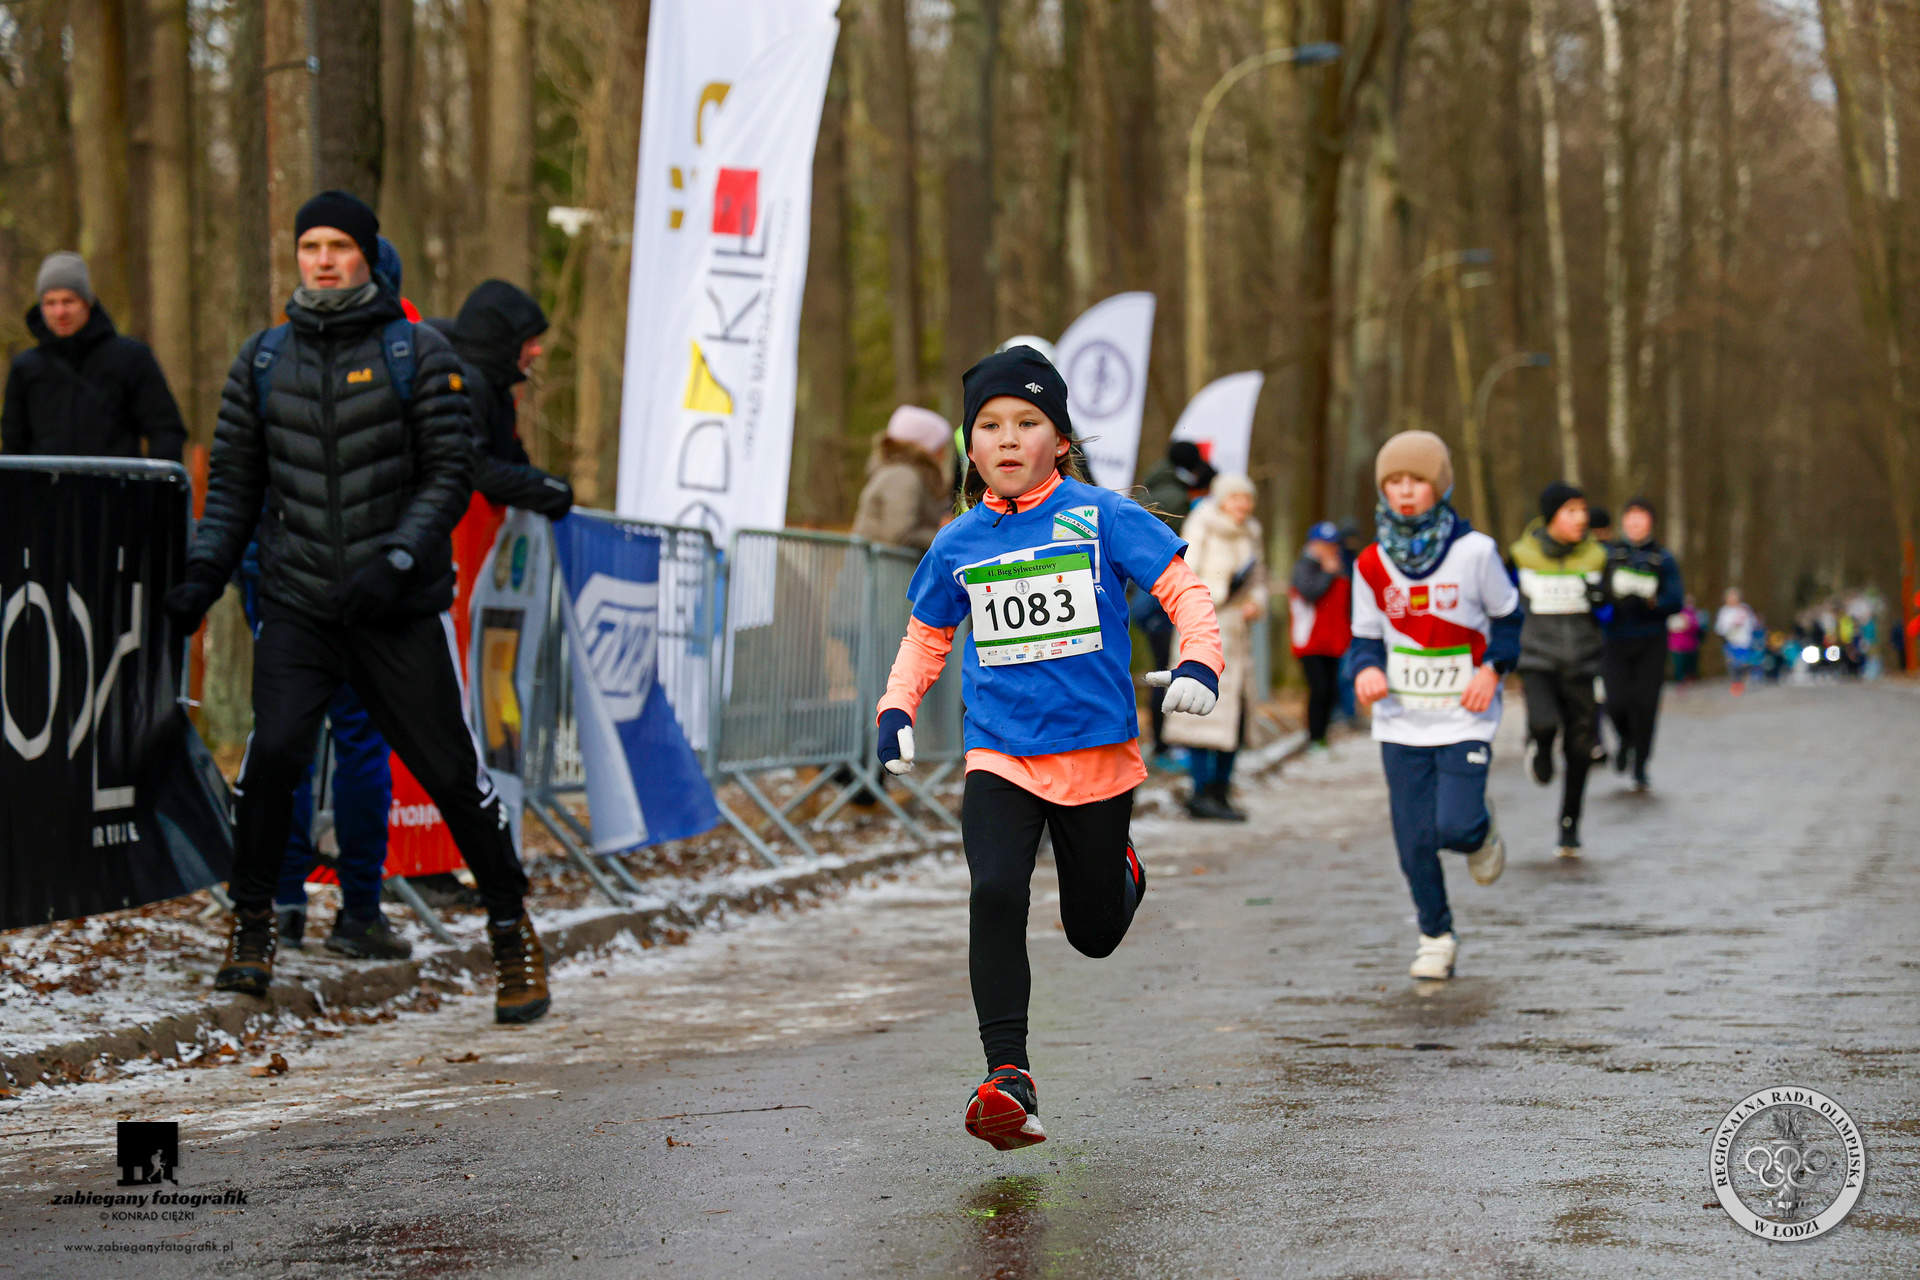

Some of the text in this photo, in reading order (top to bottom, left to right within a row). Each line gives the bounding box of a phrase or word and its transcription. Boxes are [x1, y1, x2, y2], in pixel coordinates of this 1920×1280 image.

[1025, 382, 1044, 394] 4F
[1083, 509, 1095, 518] W
[997, 568, 1013, 577] Bieg
[1012, 562, 1057, 575] Sylwestrowy
[984, 589, 1076, 632] 1083
[1401, 666, 1462, 688] 1077
